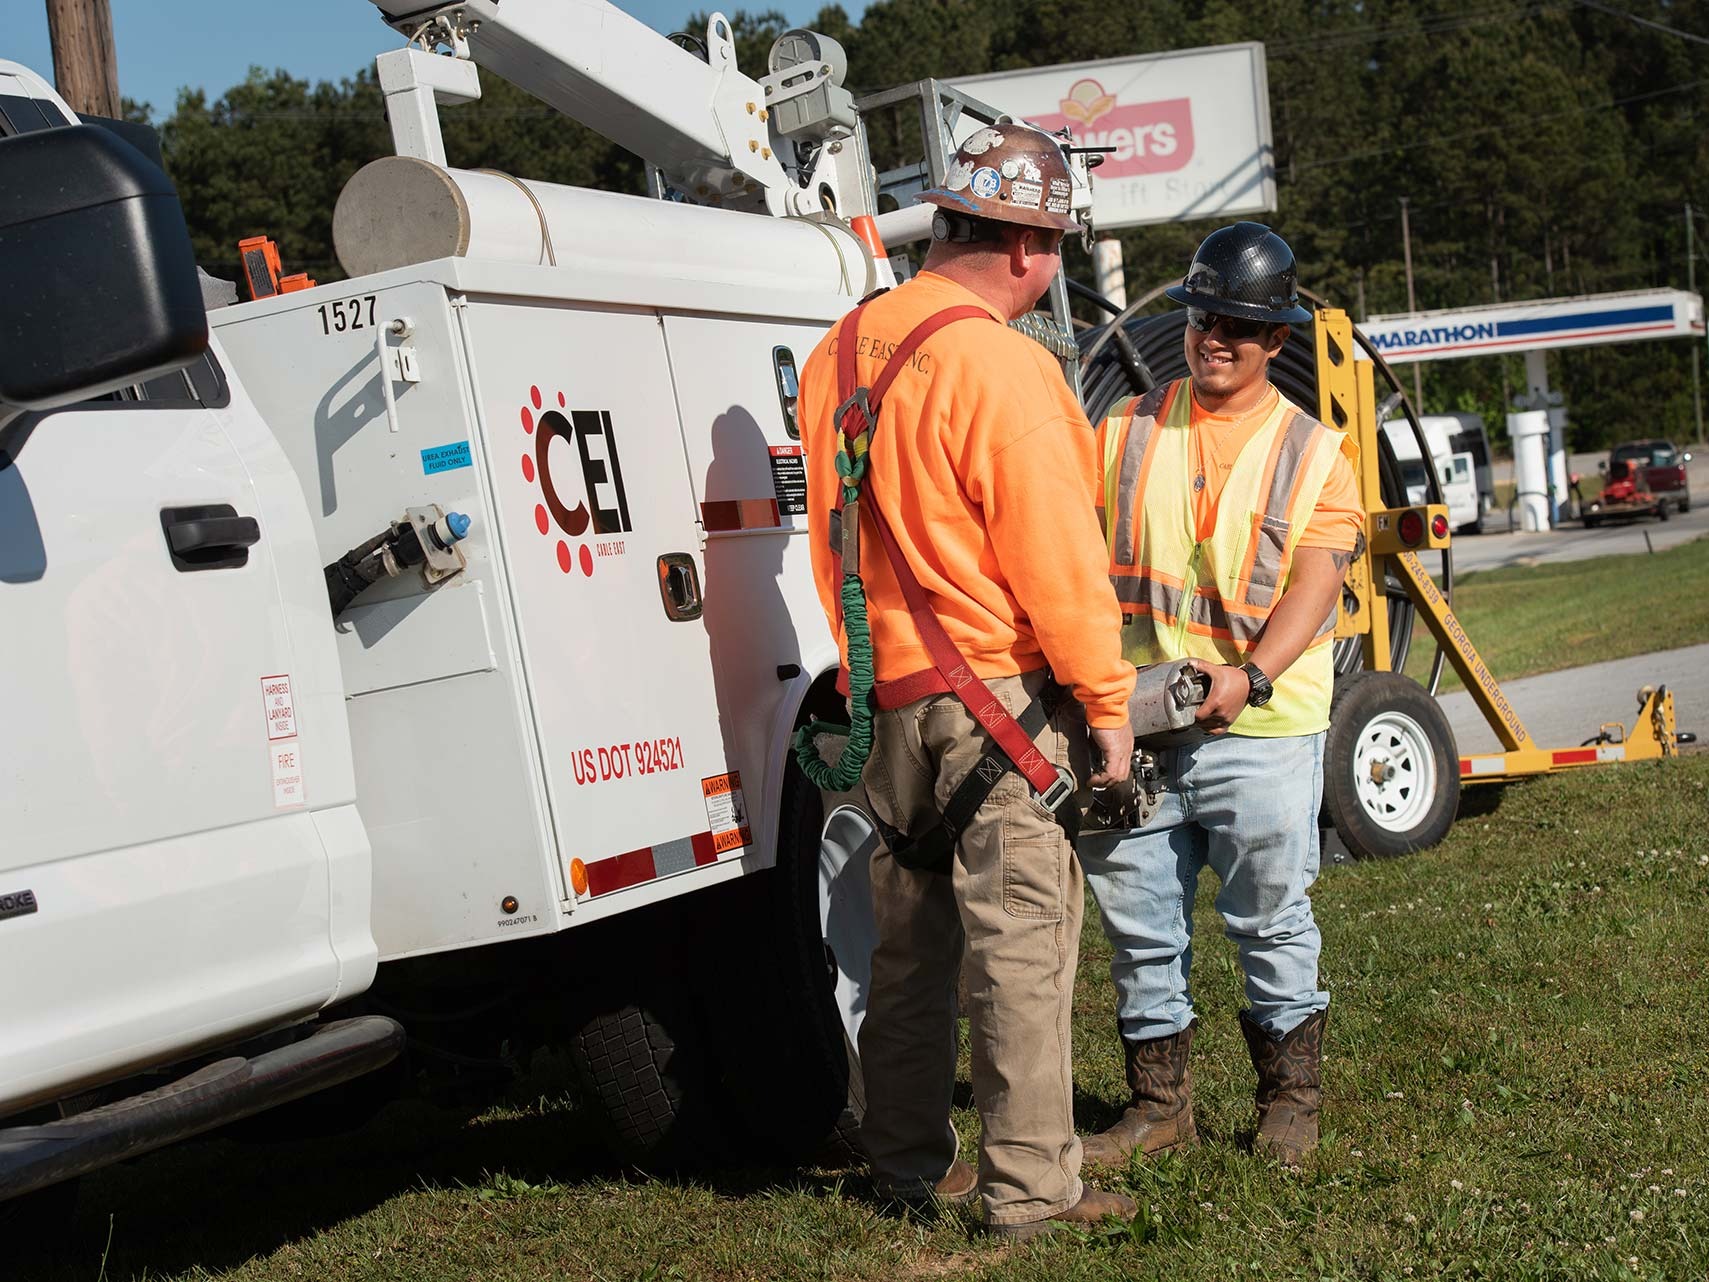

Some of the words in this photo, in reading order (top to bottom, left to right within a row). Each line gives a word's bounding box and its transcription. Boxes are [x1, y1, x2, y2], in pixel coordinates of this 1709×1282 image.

[318, 295, 377, 335] 1527
[1369, 323, 1493, 349] MARATHON
[869, 338, 901, 361] EAS
[906, 350, 931, 375] NC.
[422, 453, 440, 463] UREA
[441, 446, 470, 458] EXHAUST
[429, 460, 447, 470] FLUID
[448, 456, 466, 466] ONLY
[535, 410, 633, 537] CEI
[265, 683, 289, 697] HARNESS
[1443, 613, 1476, 664] GEORGIA
[1474, 662, 1527, 744] UNDERGROUND
[268, 706, 292, 721] LANYARD
[278, 753, 295, 769] FIRE
[571, 748, 598, 785] US
[597, 743, 633, 781] DOT
[634, 736, 685, 776] 924521
